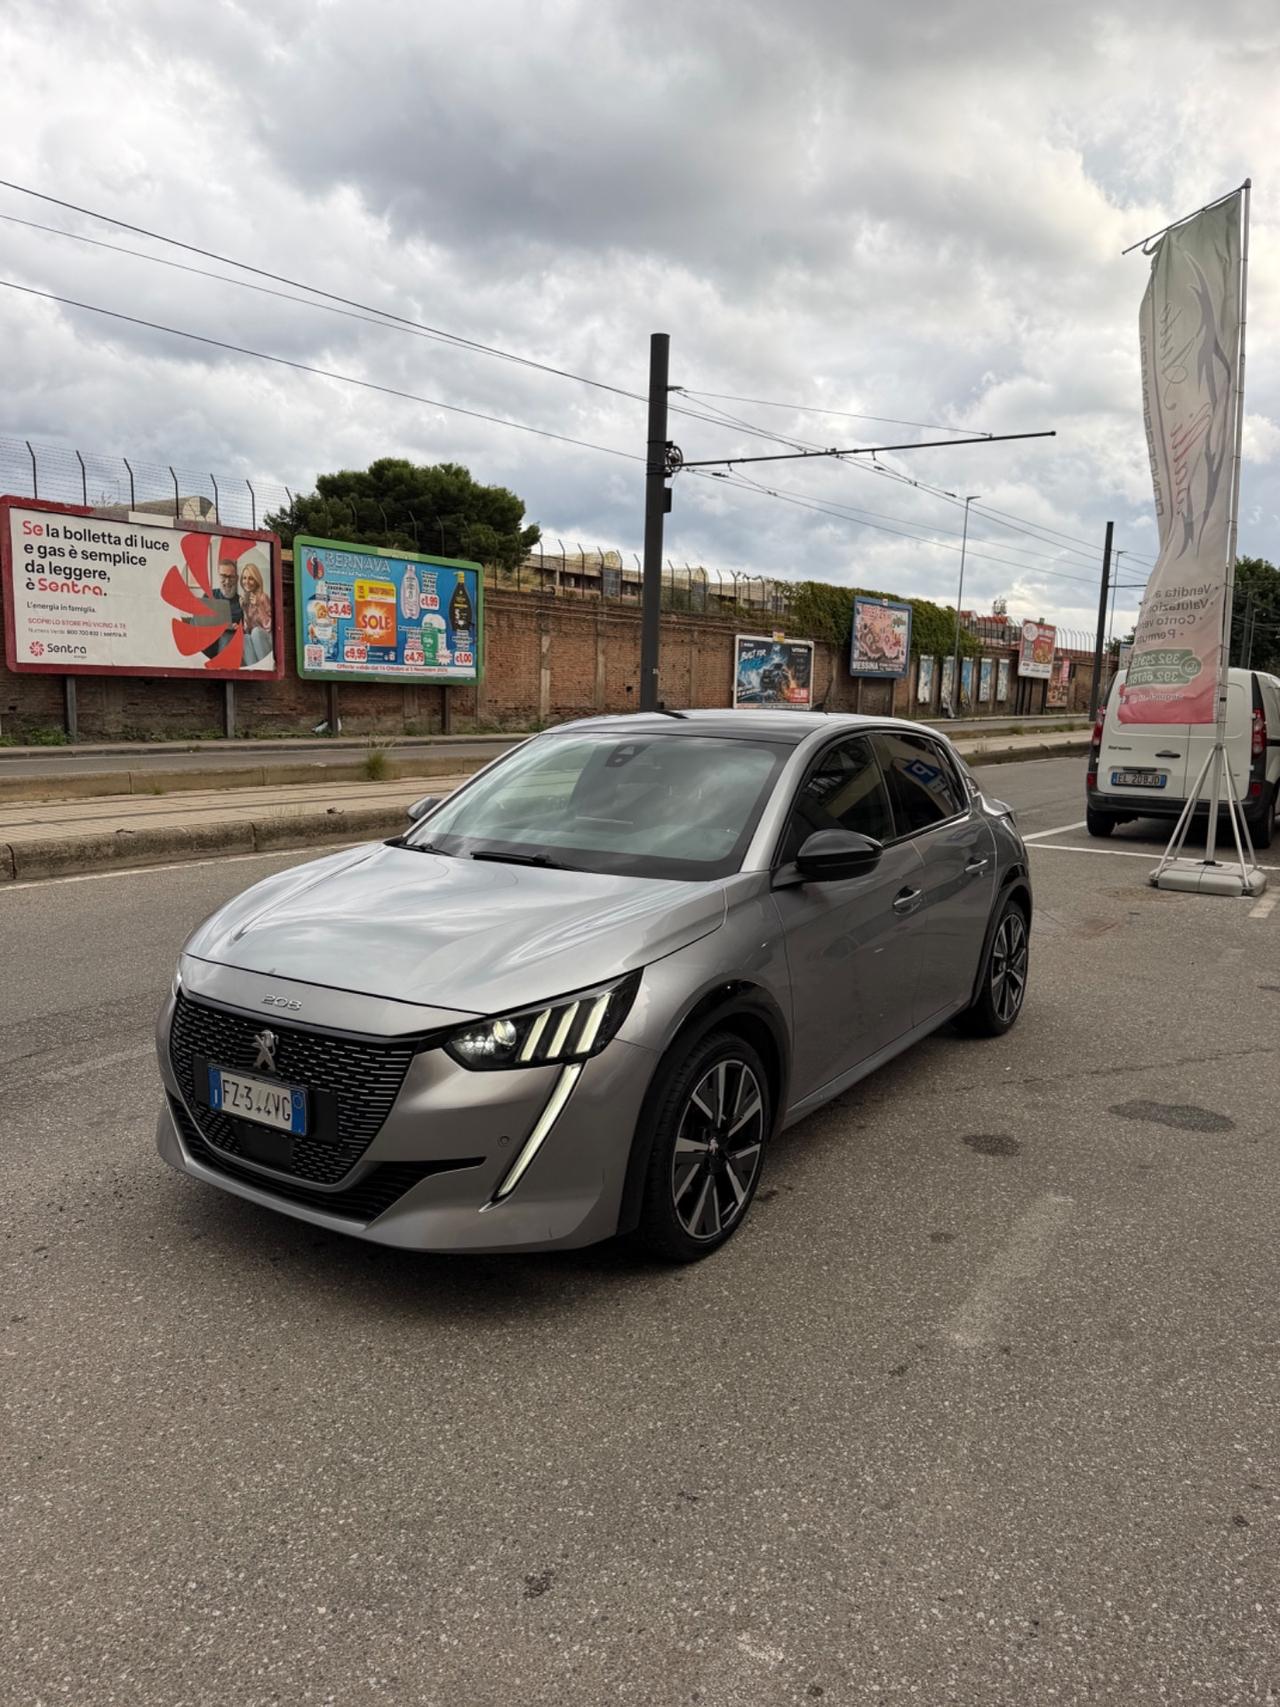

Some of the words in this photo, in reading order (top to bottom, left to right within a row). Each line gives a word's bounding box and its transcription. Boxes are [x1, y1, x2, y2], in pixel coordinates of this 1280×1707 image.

[22, 520, 43, 536] Se
[46, 523, 59, 538] la
[63, 525, 121, 545] bolletta
[124, 534, 137, 548] di
[140, 535, 170, 551] luce
[23, 543, 34, 554] e
[37, 544, 66, 559] gas
[68, 544, 78, 559] è
[80, 548, 147, 566] semplice
[325, 550, 391, 573] BERNAVA
[24, 560, 45, 574] da
[48, 561, 111, 583] leggere,
[25, 577, 36, 591] è
[38, 577, 107, 597] Sentra.
[26, 601, 59, 611] L'energia
[67, 604, 96, 614] famiglia.
[361, 613, 393, 631] SOLE
[47, 642, 87, 654] Sentra
[261, 993, 302, 1012] 208
